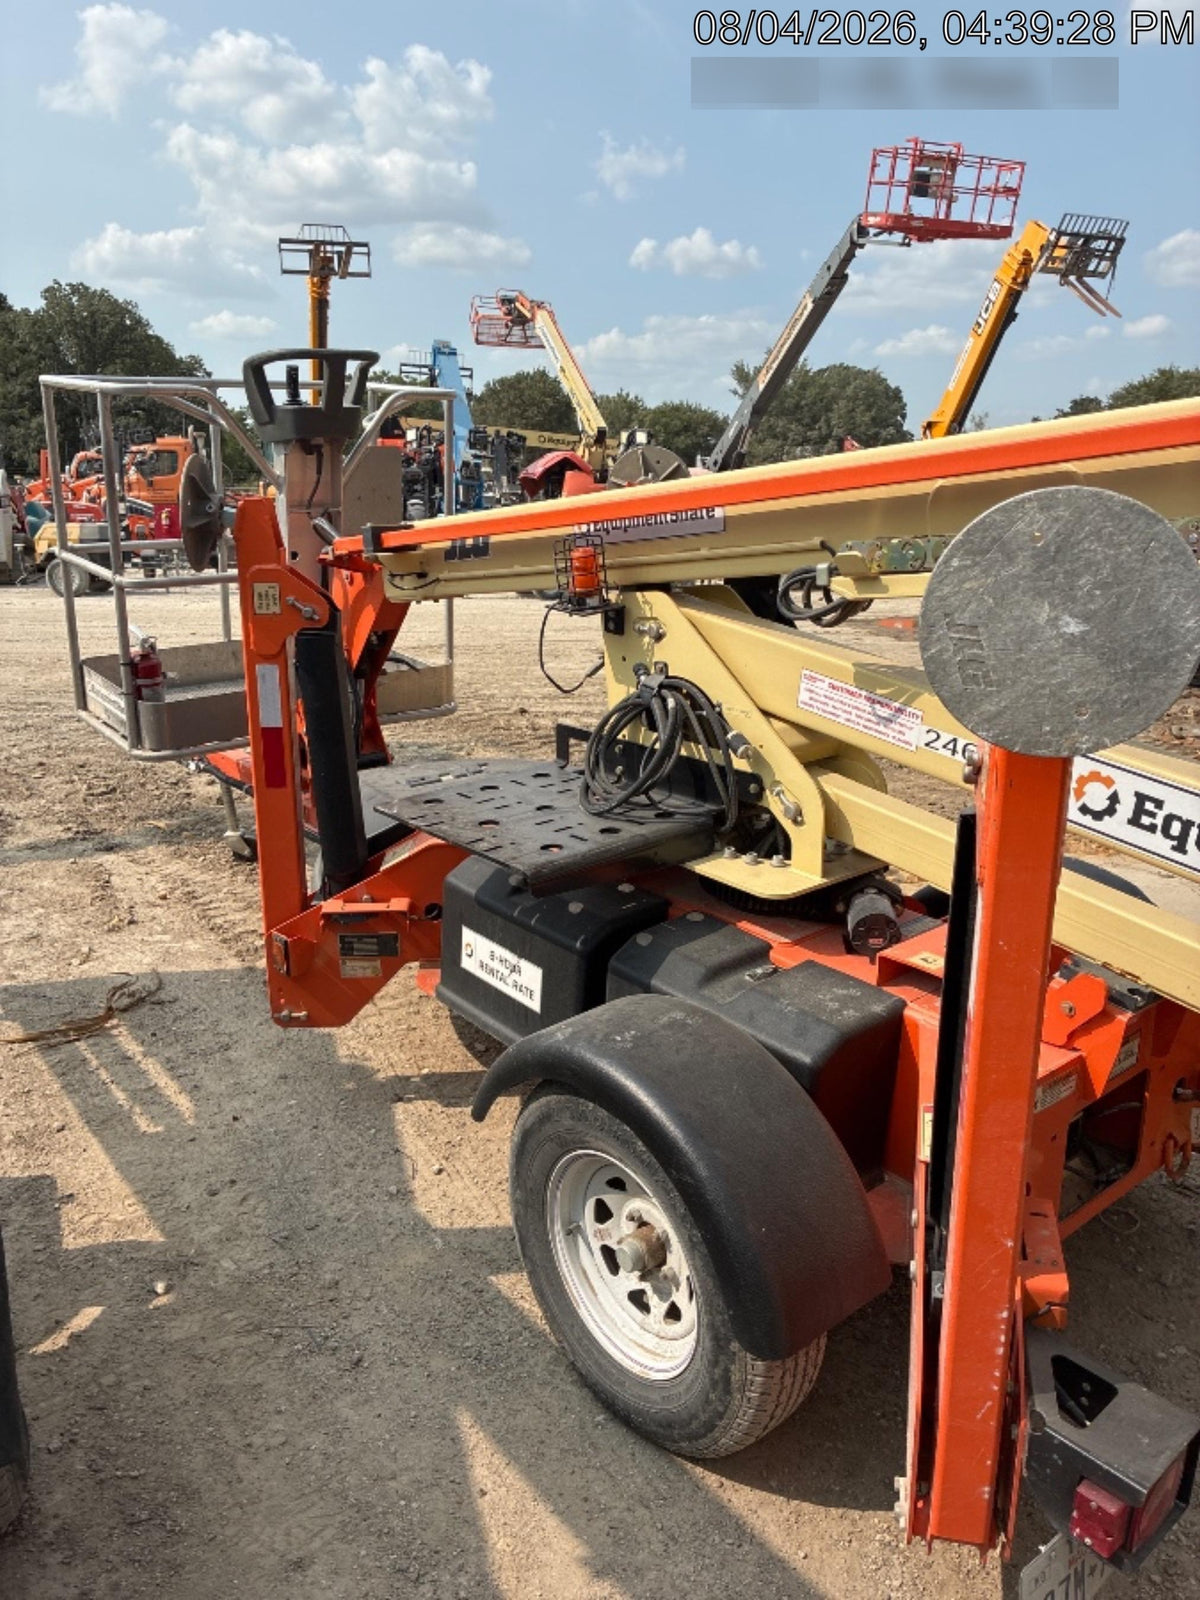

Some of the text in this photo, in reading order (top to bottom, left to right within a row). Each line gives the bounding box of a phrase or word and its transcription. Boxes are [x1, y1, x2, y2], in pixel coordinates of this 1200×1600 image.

[974, 280, 1002, 336] JCB
[1127, 790, 1200, 855] Eq
[512, 979, 535, 1002] RATE
